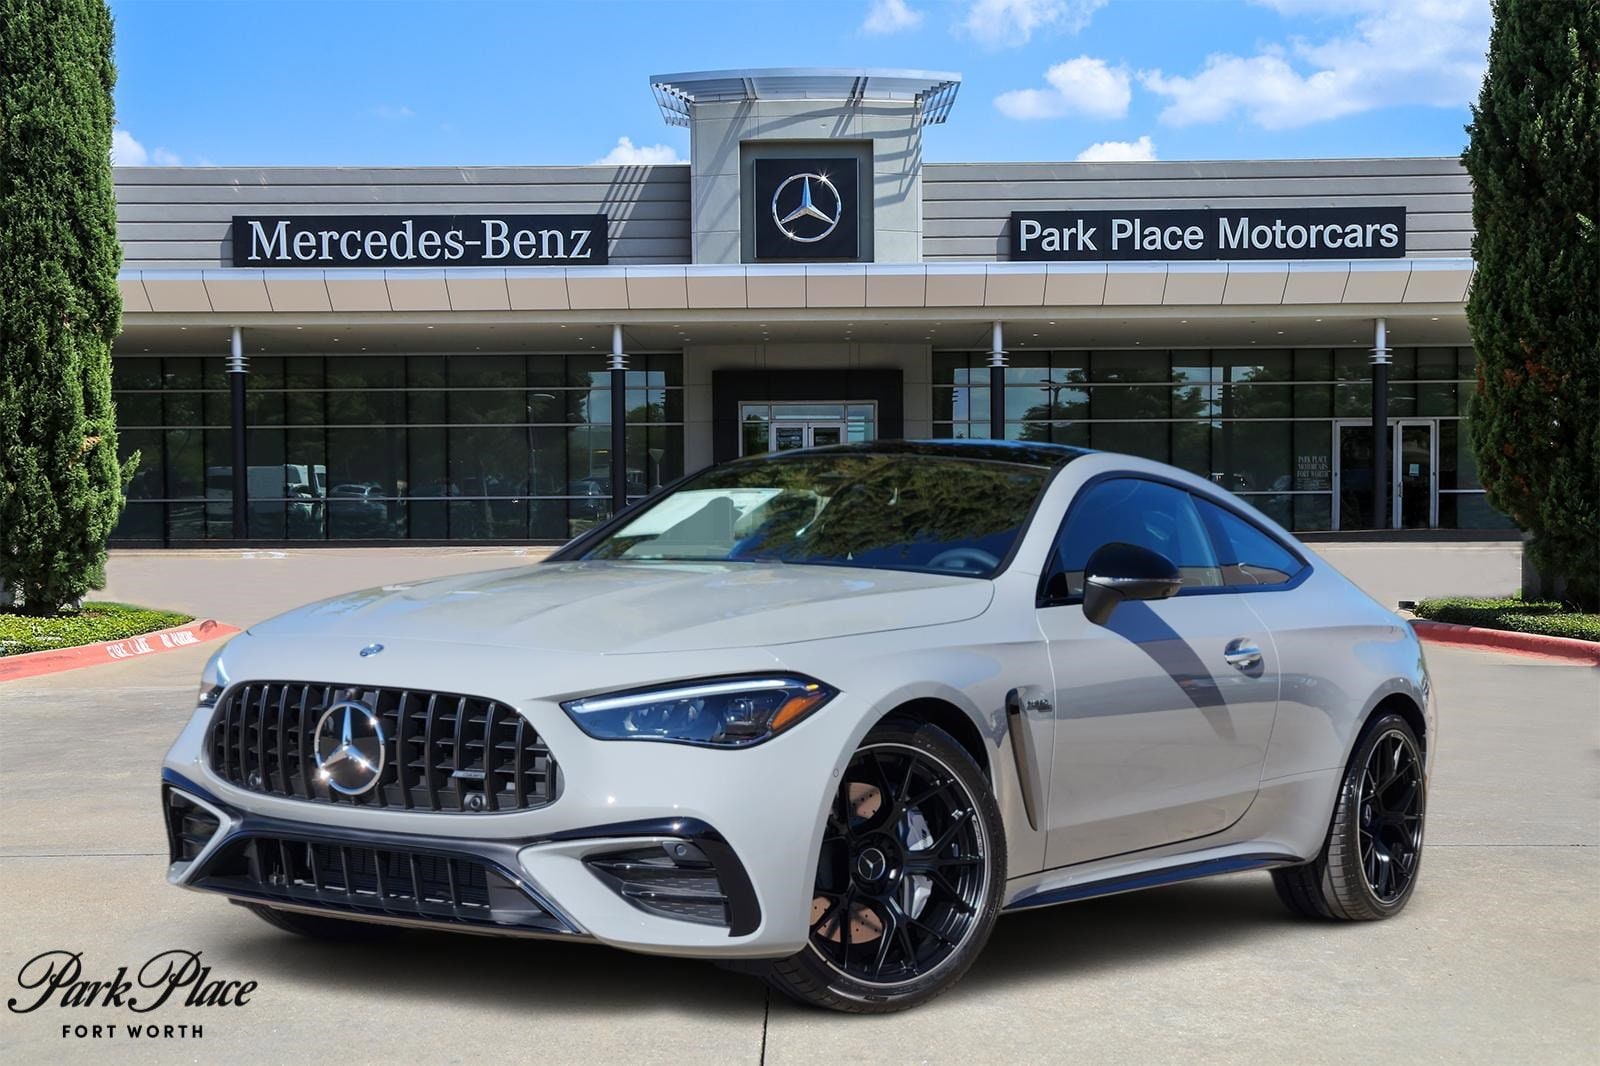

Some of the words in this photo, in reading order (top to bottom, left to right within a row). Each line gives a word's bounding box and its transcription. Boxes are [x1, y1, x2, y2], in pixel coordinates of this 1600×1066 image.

[247, 219, 592, 261] Mercedes-Benz
[1019, 219, 1098, 252] Park
[1111, 218, 1205, 251] Place
[1218, 216, 1400, 250] Motorcars
